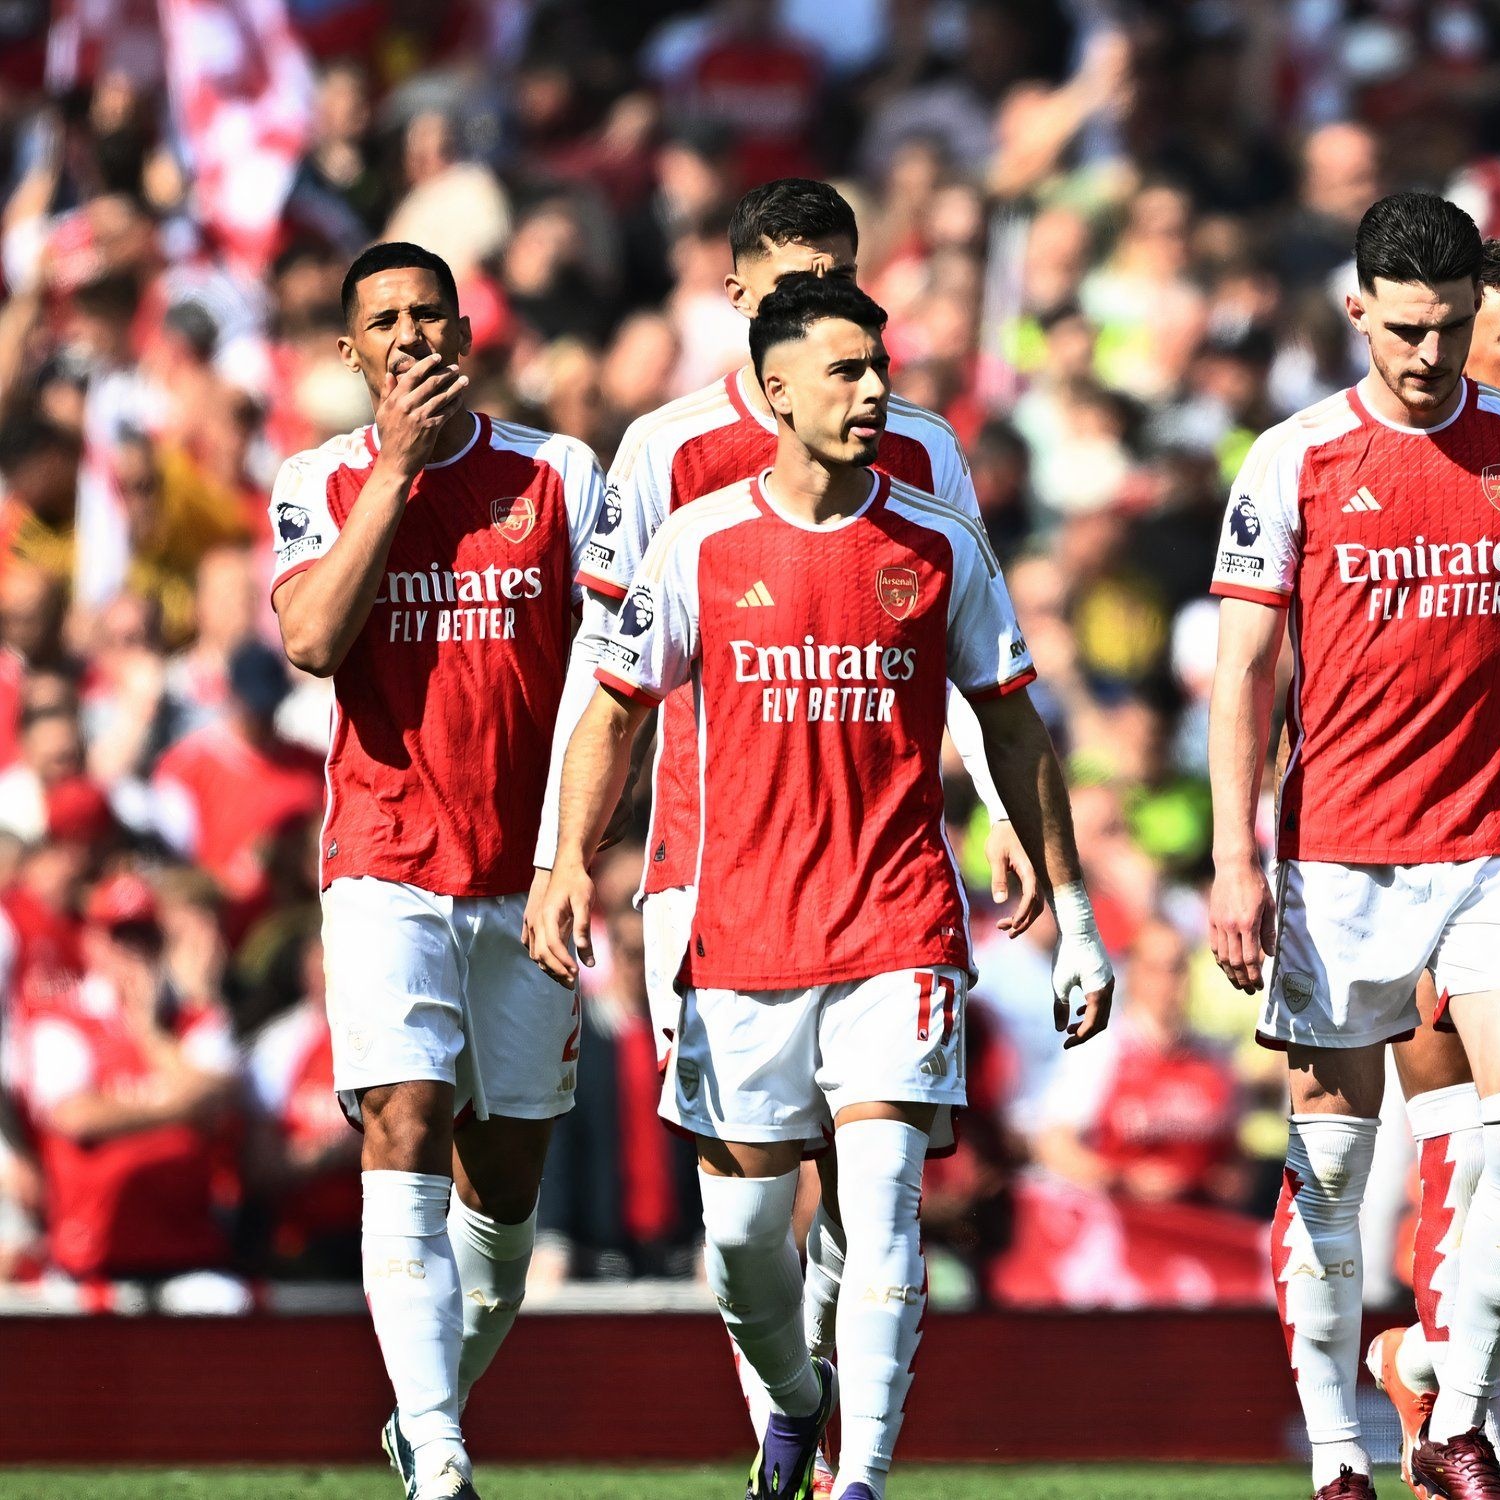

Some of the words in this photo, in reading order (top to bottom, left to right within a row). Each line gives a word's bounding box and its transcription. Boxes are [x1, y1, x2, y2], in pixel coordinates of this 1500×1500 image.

[374, 562, 543, 604] mirates
[881, 577, 913, 586] Arsenal
[1368, 586, 1410, 622] FLY
[389, 610, 428, 643] FLY
[436, 607, 516, 642] BETTER
[729, 634, 917, 683] Emirates
[763, 687, 800, 723] FLY
[807, 686, 896, 723] BETTER
[914, 972, 955, 1046] 11
